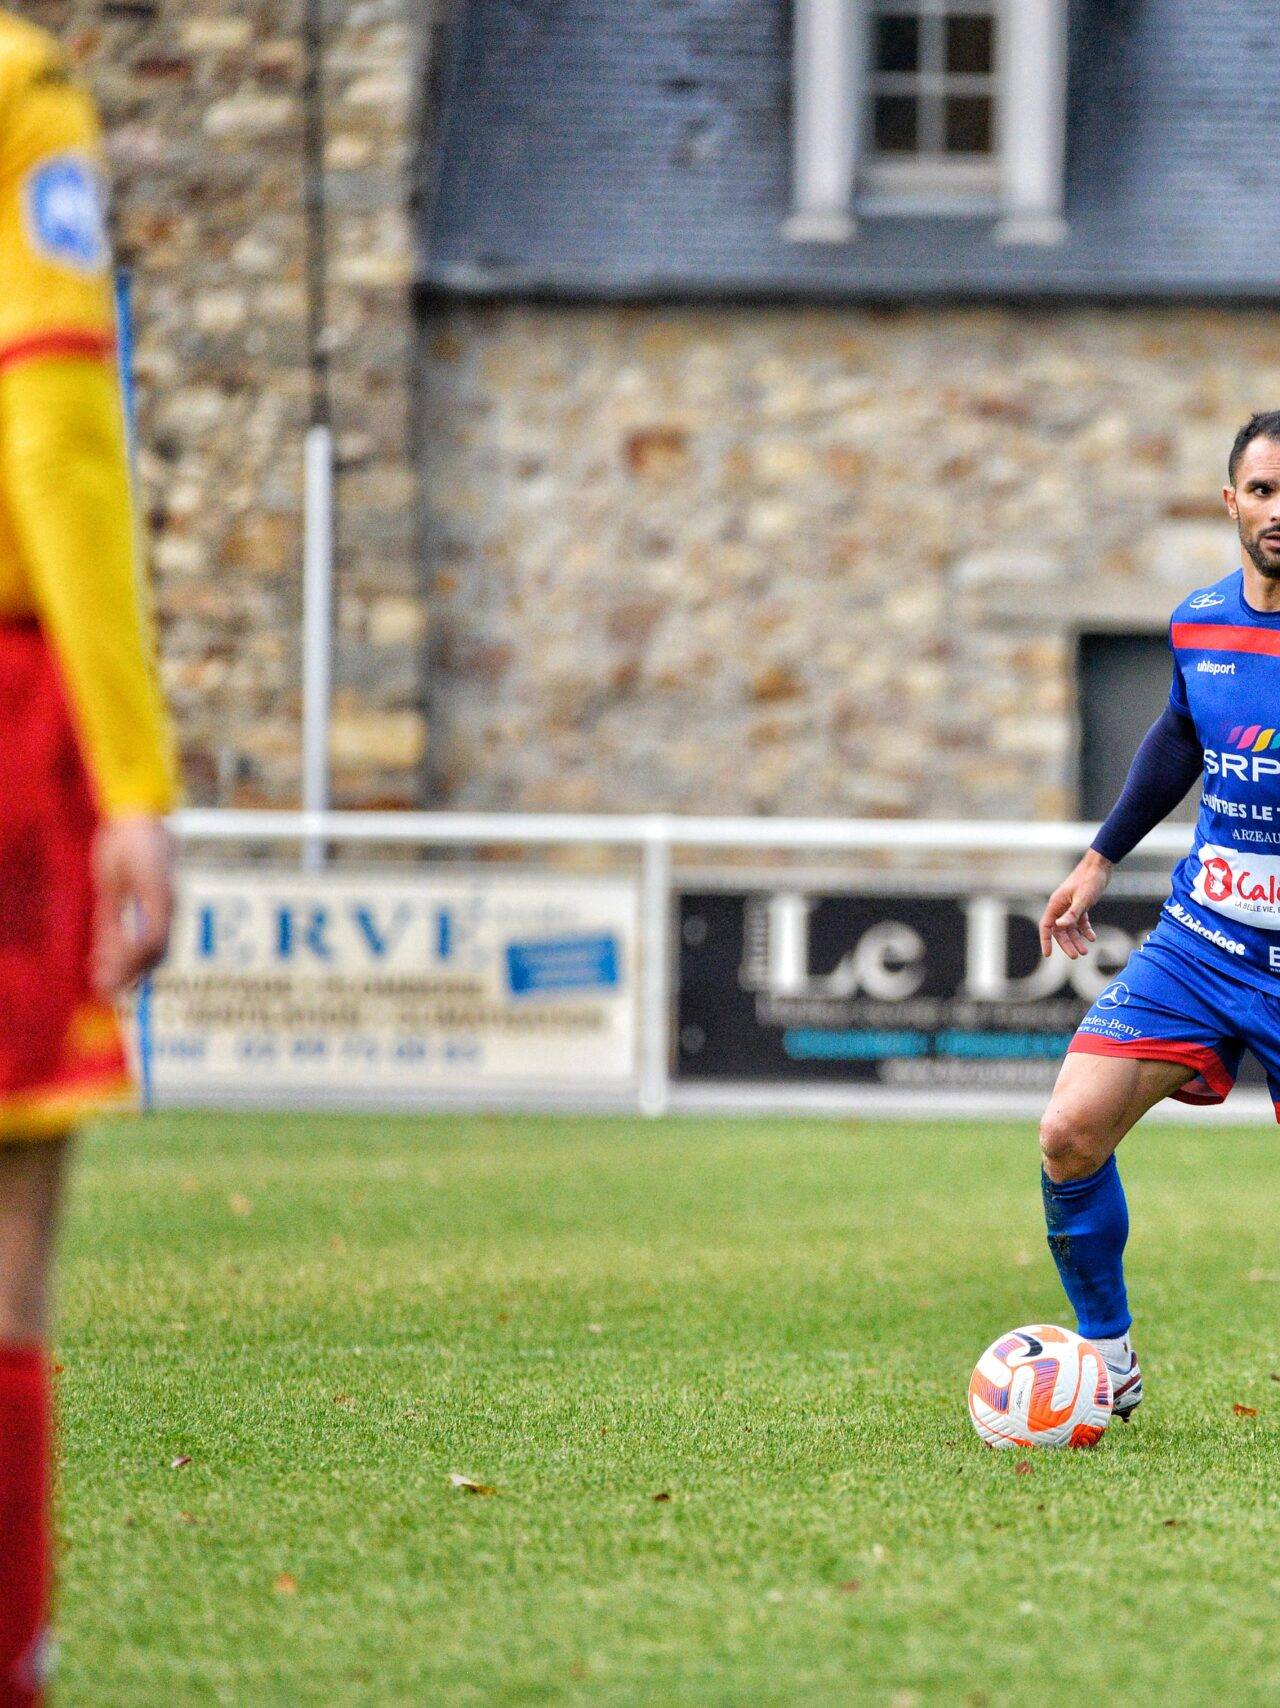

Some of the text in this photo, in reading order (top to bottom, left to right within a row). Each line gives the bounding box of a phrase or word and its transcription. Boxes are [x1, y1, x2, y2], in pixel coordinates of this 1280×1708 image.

[1196, 660, 1236, 676] uhlsport
[1251, 804, 1274, 821] LE
[1082, 1014, 1142, 1038] edes-Benz
[1091, 1027, 1125, 1040] ALLANIC
